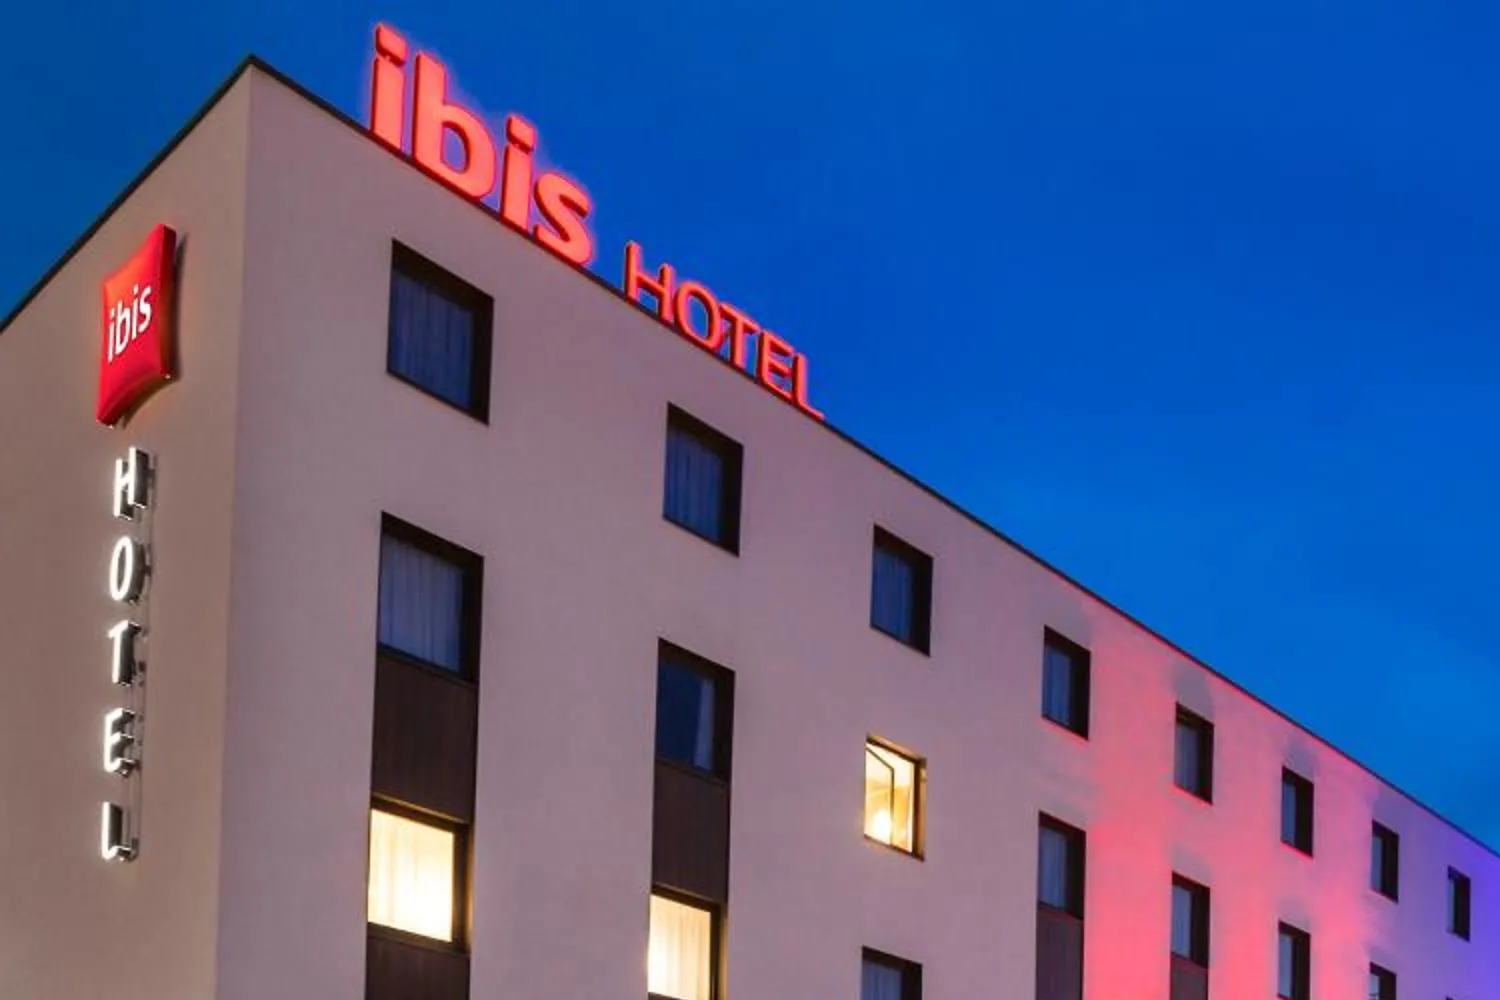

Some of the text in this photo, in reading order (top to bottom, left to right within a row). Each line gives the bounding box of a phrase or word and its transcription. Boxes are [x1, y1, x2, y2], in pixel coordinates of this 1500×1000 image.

[107, 283, 153, 363] ibis
[369, 23, 826, 421] ibis HOTEL
[101, 447, 149, 862] HOTEL
